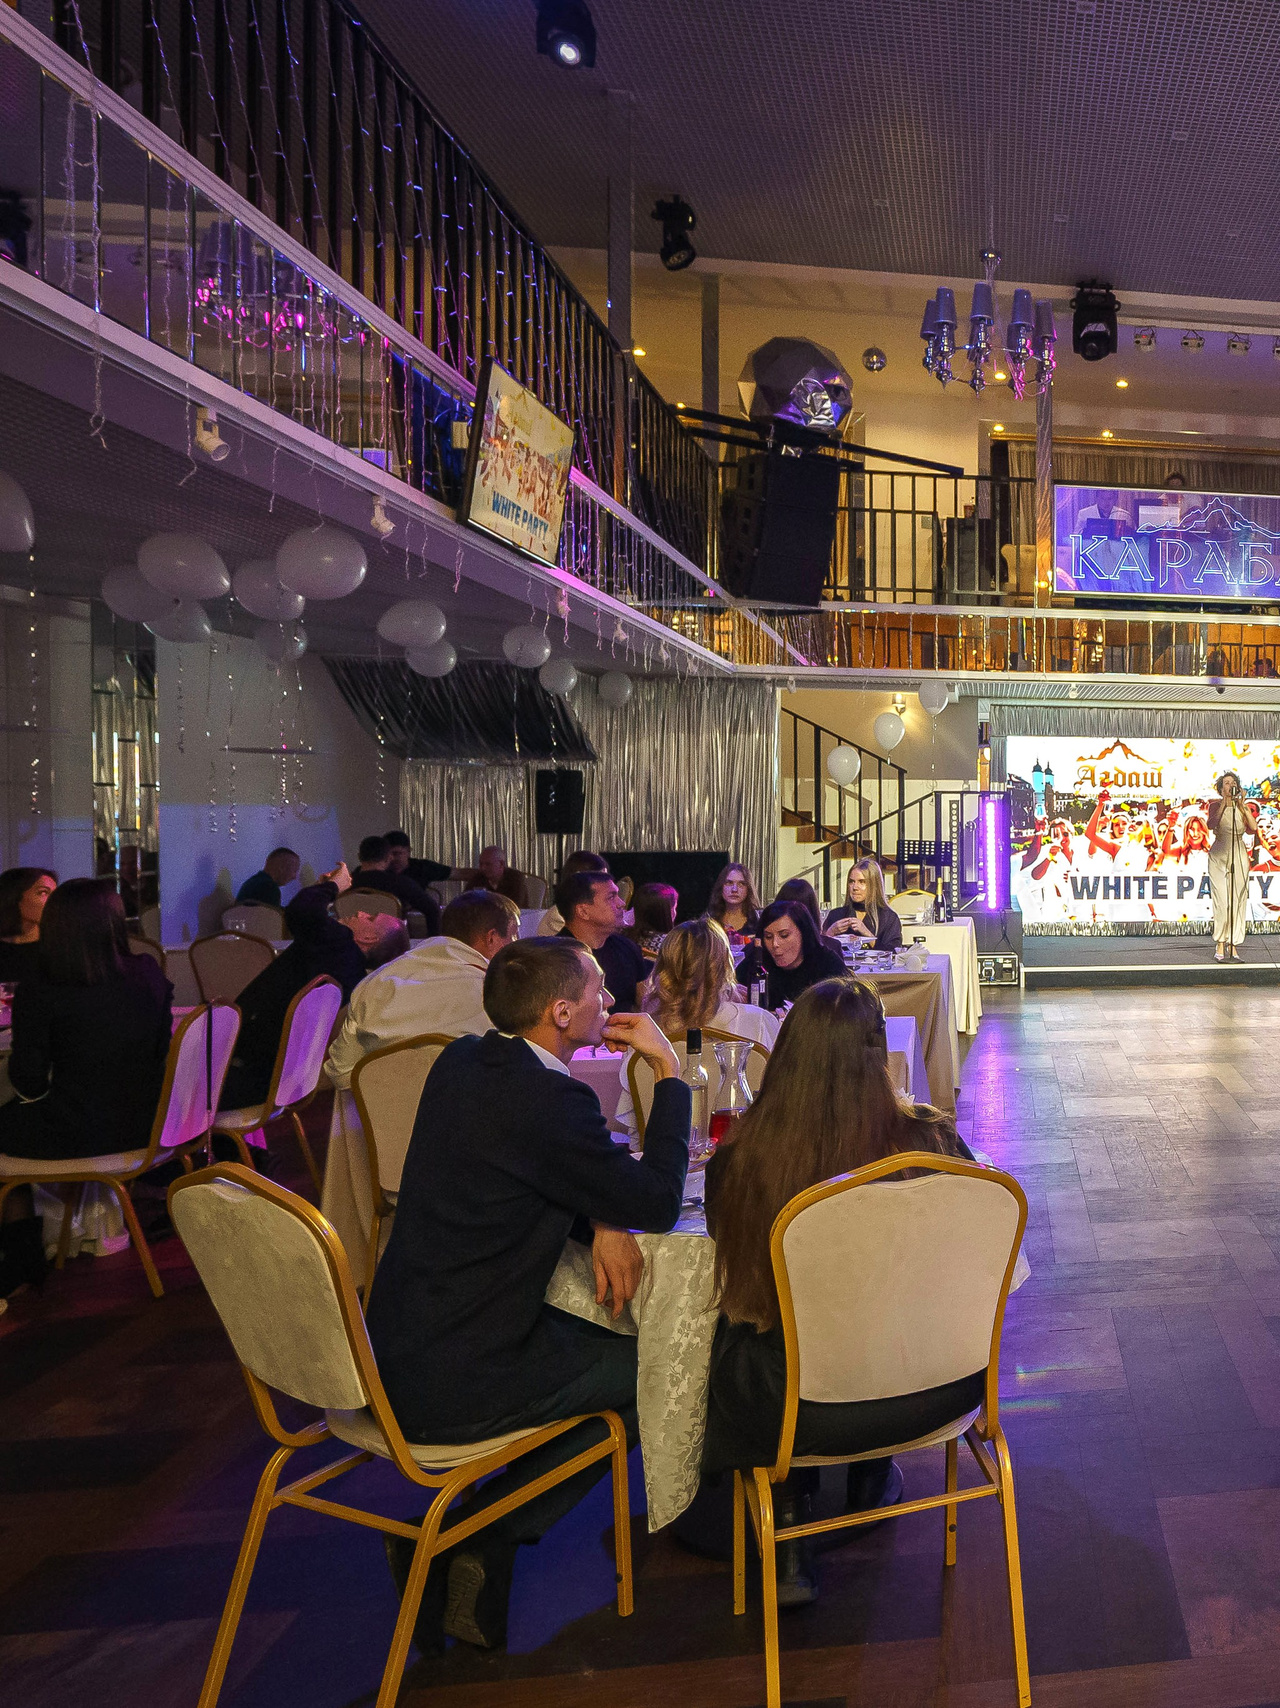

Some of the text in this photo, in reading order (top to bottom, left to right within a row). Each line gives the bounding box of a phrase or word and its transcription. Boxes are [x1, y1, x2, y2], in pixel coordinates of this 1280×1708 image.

[492, 490, 549, 541] WHITE PARTY
[1070, 876, 1274, 900] WHITE PAY
